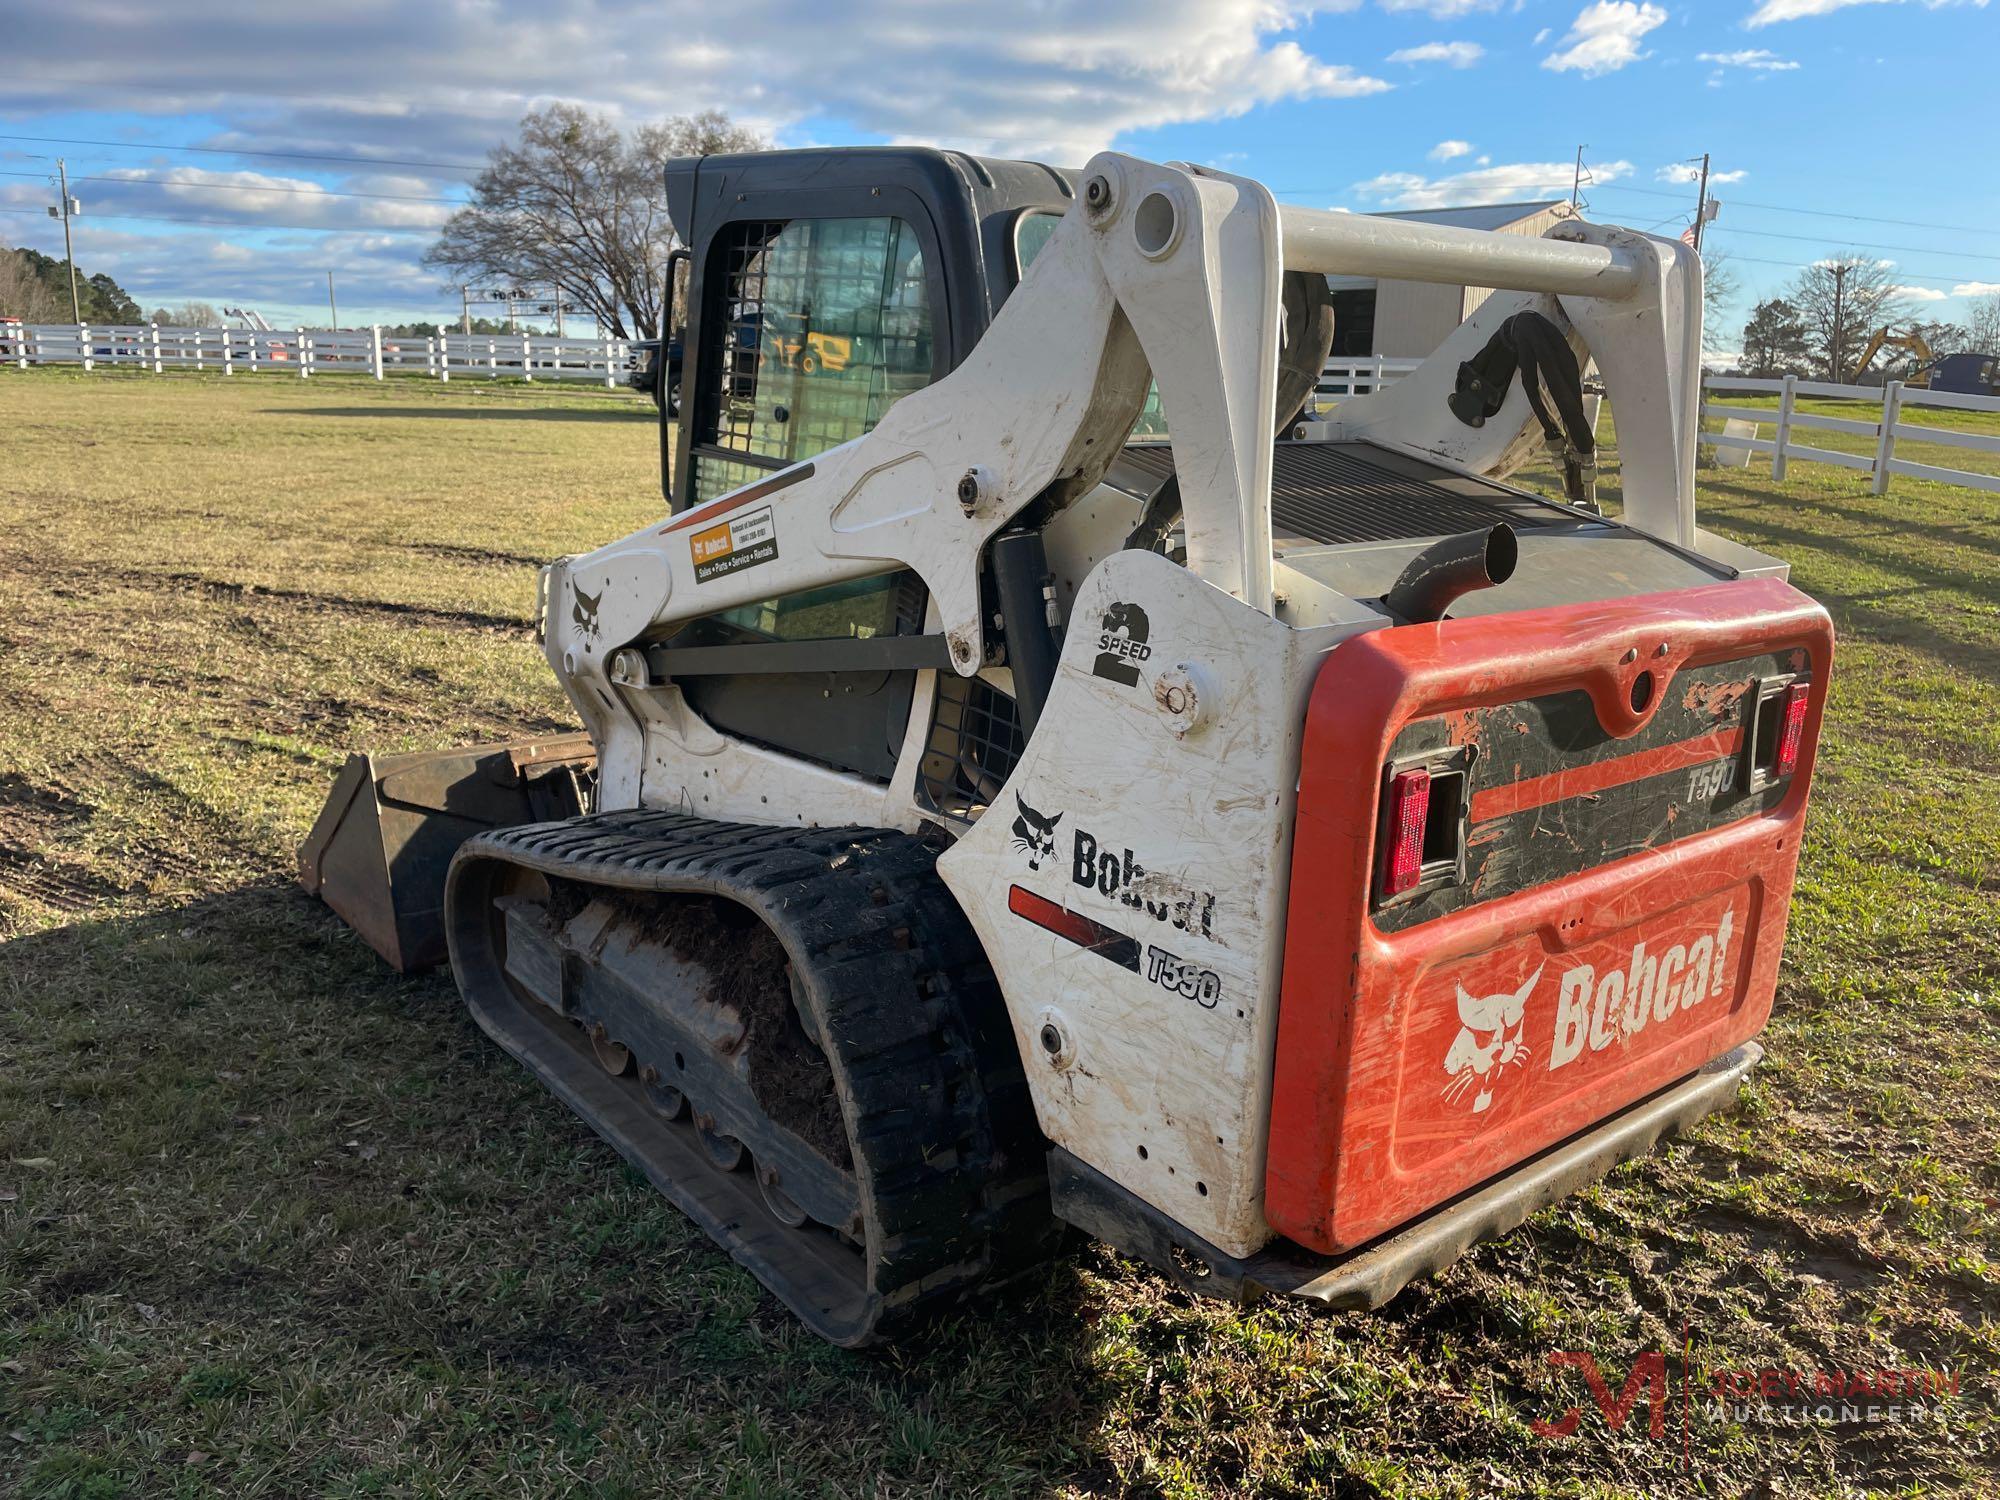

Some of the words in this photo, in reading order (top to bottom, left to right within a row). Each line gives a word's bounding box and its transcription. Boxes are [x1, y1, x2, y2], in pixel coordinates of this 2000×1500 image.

[699, 566, 712, 578] Sales
[715, 561, 728, 573] Parts
[732, 555, 750, 567] Service
[754, 546, 773, 560] Rentals
[1097, 634, 1152, 662] SPEED
[1687, 759, 1736, 804] T590
[1148, 944, 1221, 1009] T590
[1549, 908, 1734, 1071] Bobcat
